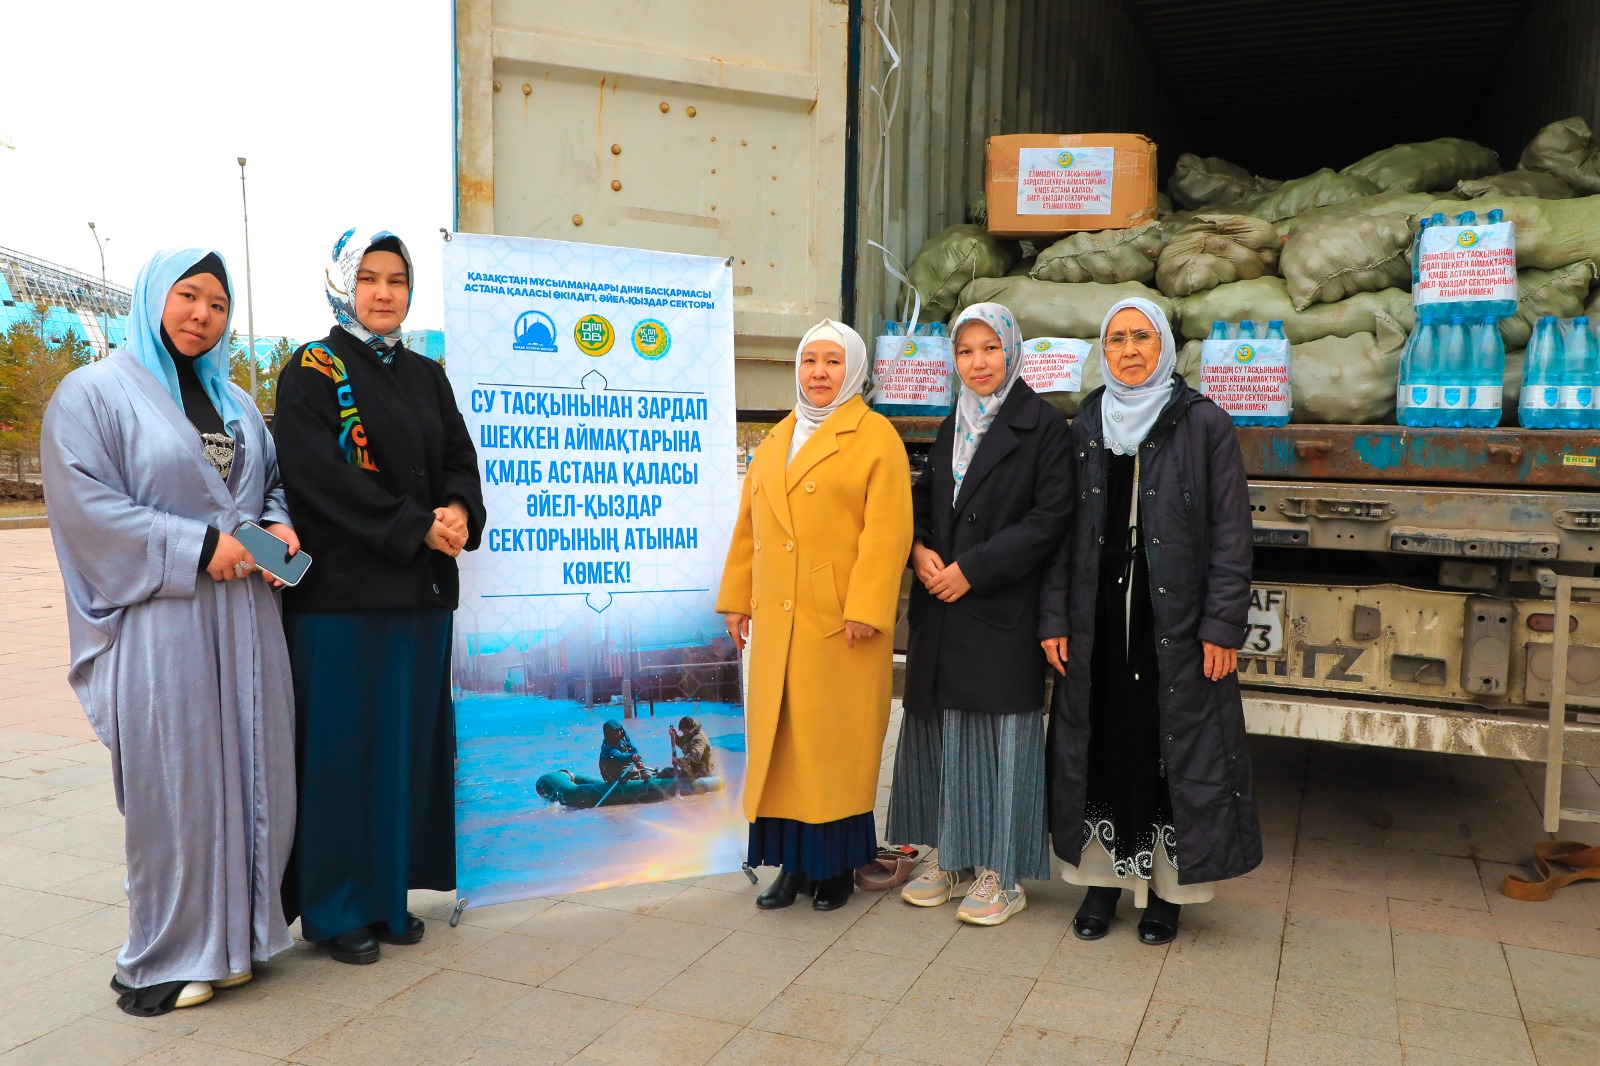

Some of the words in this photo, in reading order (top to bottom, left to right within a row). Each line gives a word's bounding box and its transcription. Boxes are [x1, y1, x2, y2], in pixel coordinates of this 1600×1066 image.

[1023, 178, 1043, 186] ЗАРДАП
[1467, 248, 1513, 258] ТАСҚЫНЫНАН
[1441, 260, 1469, 269] ШЕККЕН
[1428, 270, 1449, 279] ҚМДБ
[1450, 269, 1476, 278] АСТАНА
[1477, 267, 1506, 277] ҚАЛАСЫ
[467, 271, 528, 285] ҚАЗАҚСТАН
[530, 277, 619, 293] МҰСЫЛМАНДАРЫ
[620, 285, 644, 295] ДІНИ
[645, 286, 712, 299] БАСҚАРМАСЫ
[464, 283, 506, 295] АСТАНА
[507, 287, 552, 298] ҚАЛАСЫ
[553, 290, 598, 303] ӨКІЛДІГІ,
[598, 293, 669, 308] ӘЙЕЛ-ҚЫЗДАР
[669, 299, 715, 310] СЕКТОРЫ
[1439, 288, 1468, 297] АТЫНАН
[1468, 287, 1494, 295] КӨМЕК!
[892, 367, 910, 375] ЕККЕН
[1244, 366, 1287, 374] ТАСҚЫНЫНАН
[1220, 375, 1246, 383] ШЕККЕН
[1208, 384, 1227, 392] ҚМДБ
[1252, 385, 1280, 393] ҚАЛАСЫ
[885, 392, 908, 400] АТЫНАН
[471, 389, 495, 413] СУ
[501, 390, 633, 419] ТАСҚЫНЫНАН
[638, 396, 708, 422] ЗАРДАП
[1244, 403, 1268, 411] КӨМЕК!
[480, 424, 559, 450] ШЕККЕН
[564, 423, 702, 454] АЙМАҚТАРЫНА
[485, 459, 543, 486] ҚМДБ
[547, 460, 618, 484] АСТАНА
[623, 462, 698, 487] ҚАЛАСЫ
[526, 490, 662, 520] ӘЙЕЛ-ҚЫЗДАР
[489, 527, 619, 553] СЕКТОРЫНЫҢ
[624, 527, 698, 550] АТЫНАН
[563, 561, 631, 585] КӨМЕК!
